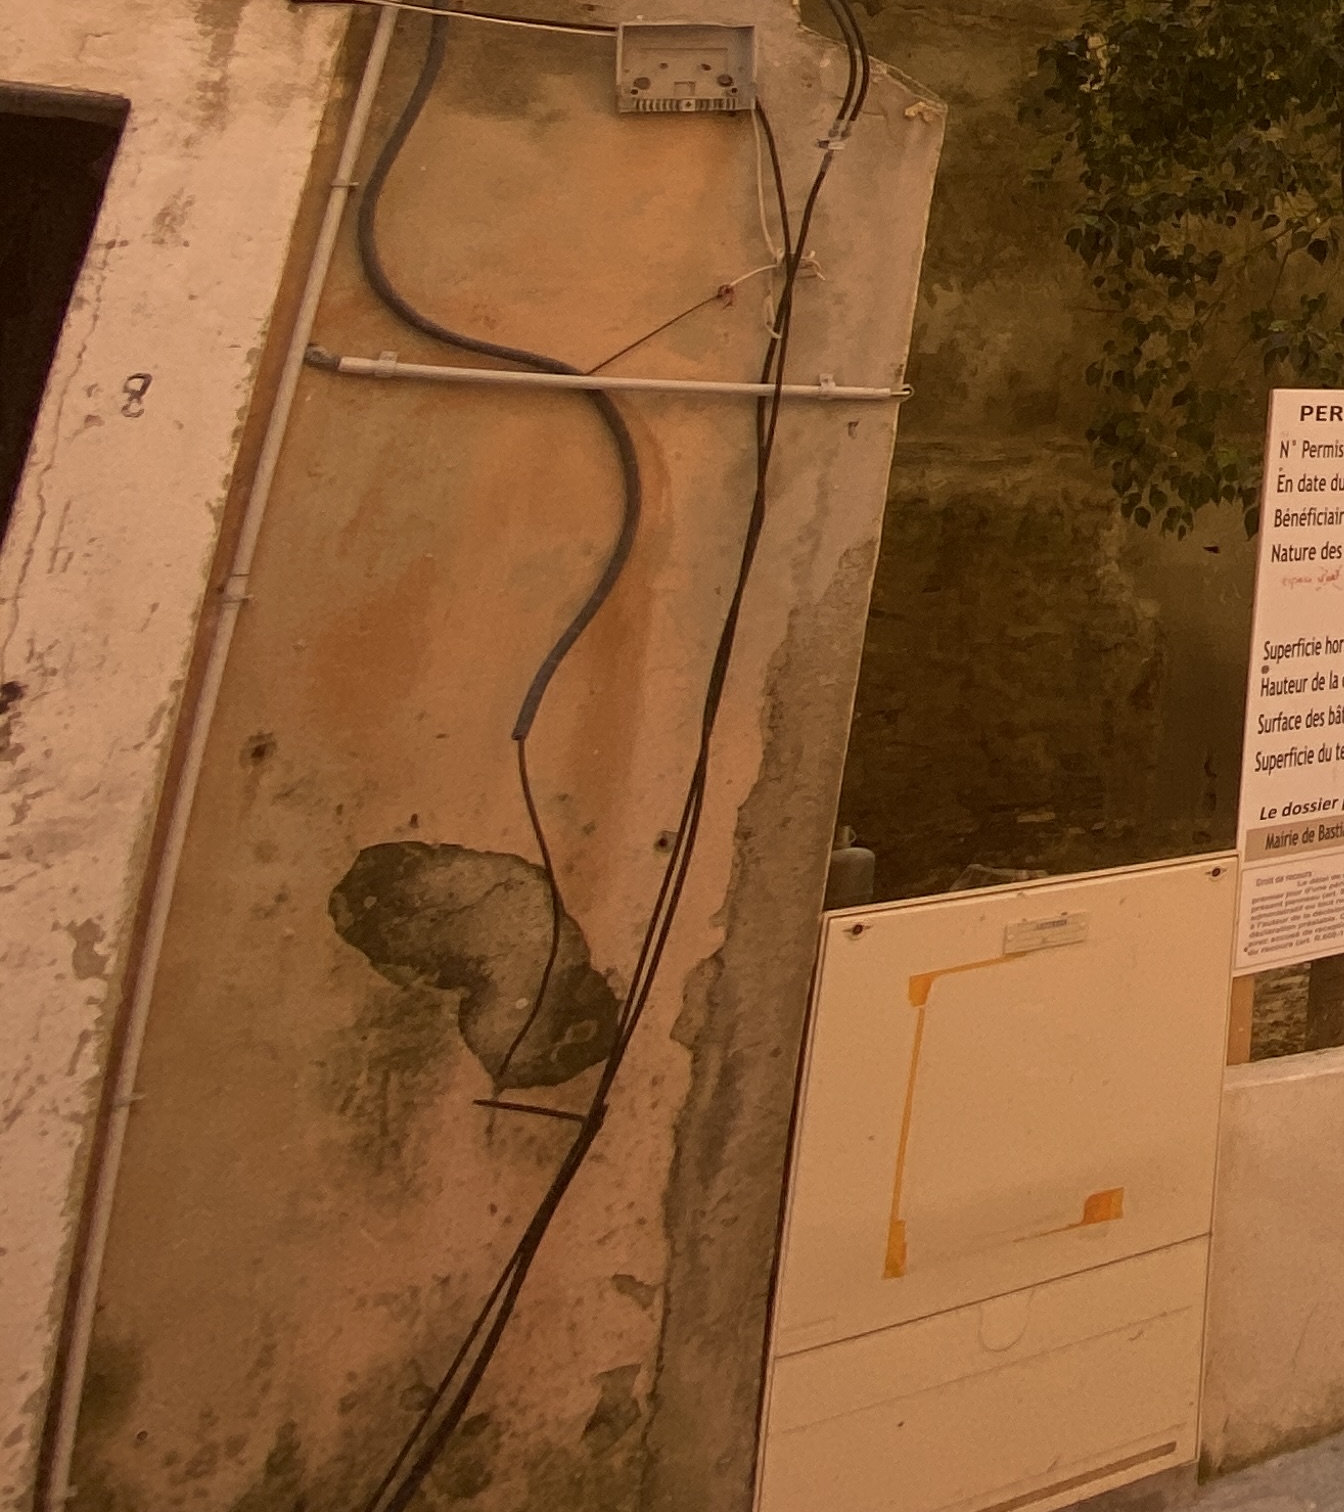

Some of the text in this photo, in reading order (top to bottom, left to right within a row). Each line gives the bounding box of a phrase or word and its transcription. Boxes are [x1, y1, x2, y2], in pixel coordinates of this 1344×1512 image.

[1301, 439, 1344, 459] Permis
[1277, 474, 1293, 493] En
[1297, 473, 1326, 493] date
[1271, 544, 1317, 563] Nature
[1320, 541, 1342, 560] des
[1263, 637, 1322, 664] Superficie
[1260, 676, 1308, 697] Hauteur
[1311, 672, 1326, 692] de
[1328, 670, 1339, 690] la
[1257, 711, 1302, 734] Surface
[1305, 708, 1325, 729] des
[1254, 745, 1314, 776] Superficie
[1318, 743, 1332, 764] du
[1260, 807, 1277, 820] Le
[1281, 797, 1339, 817] dossier
[1265, 829, 1299, 850] Mairie
[1301, 827, 1315, 845] de
